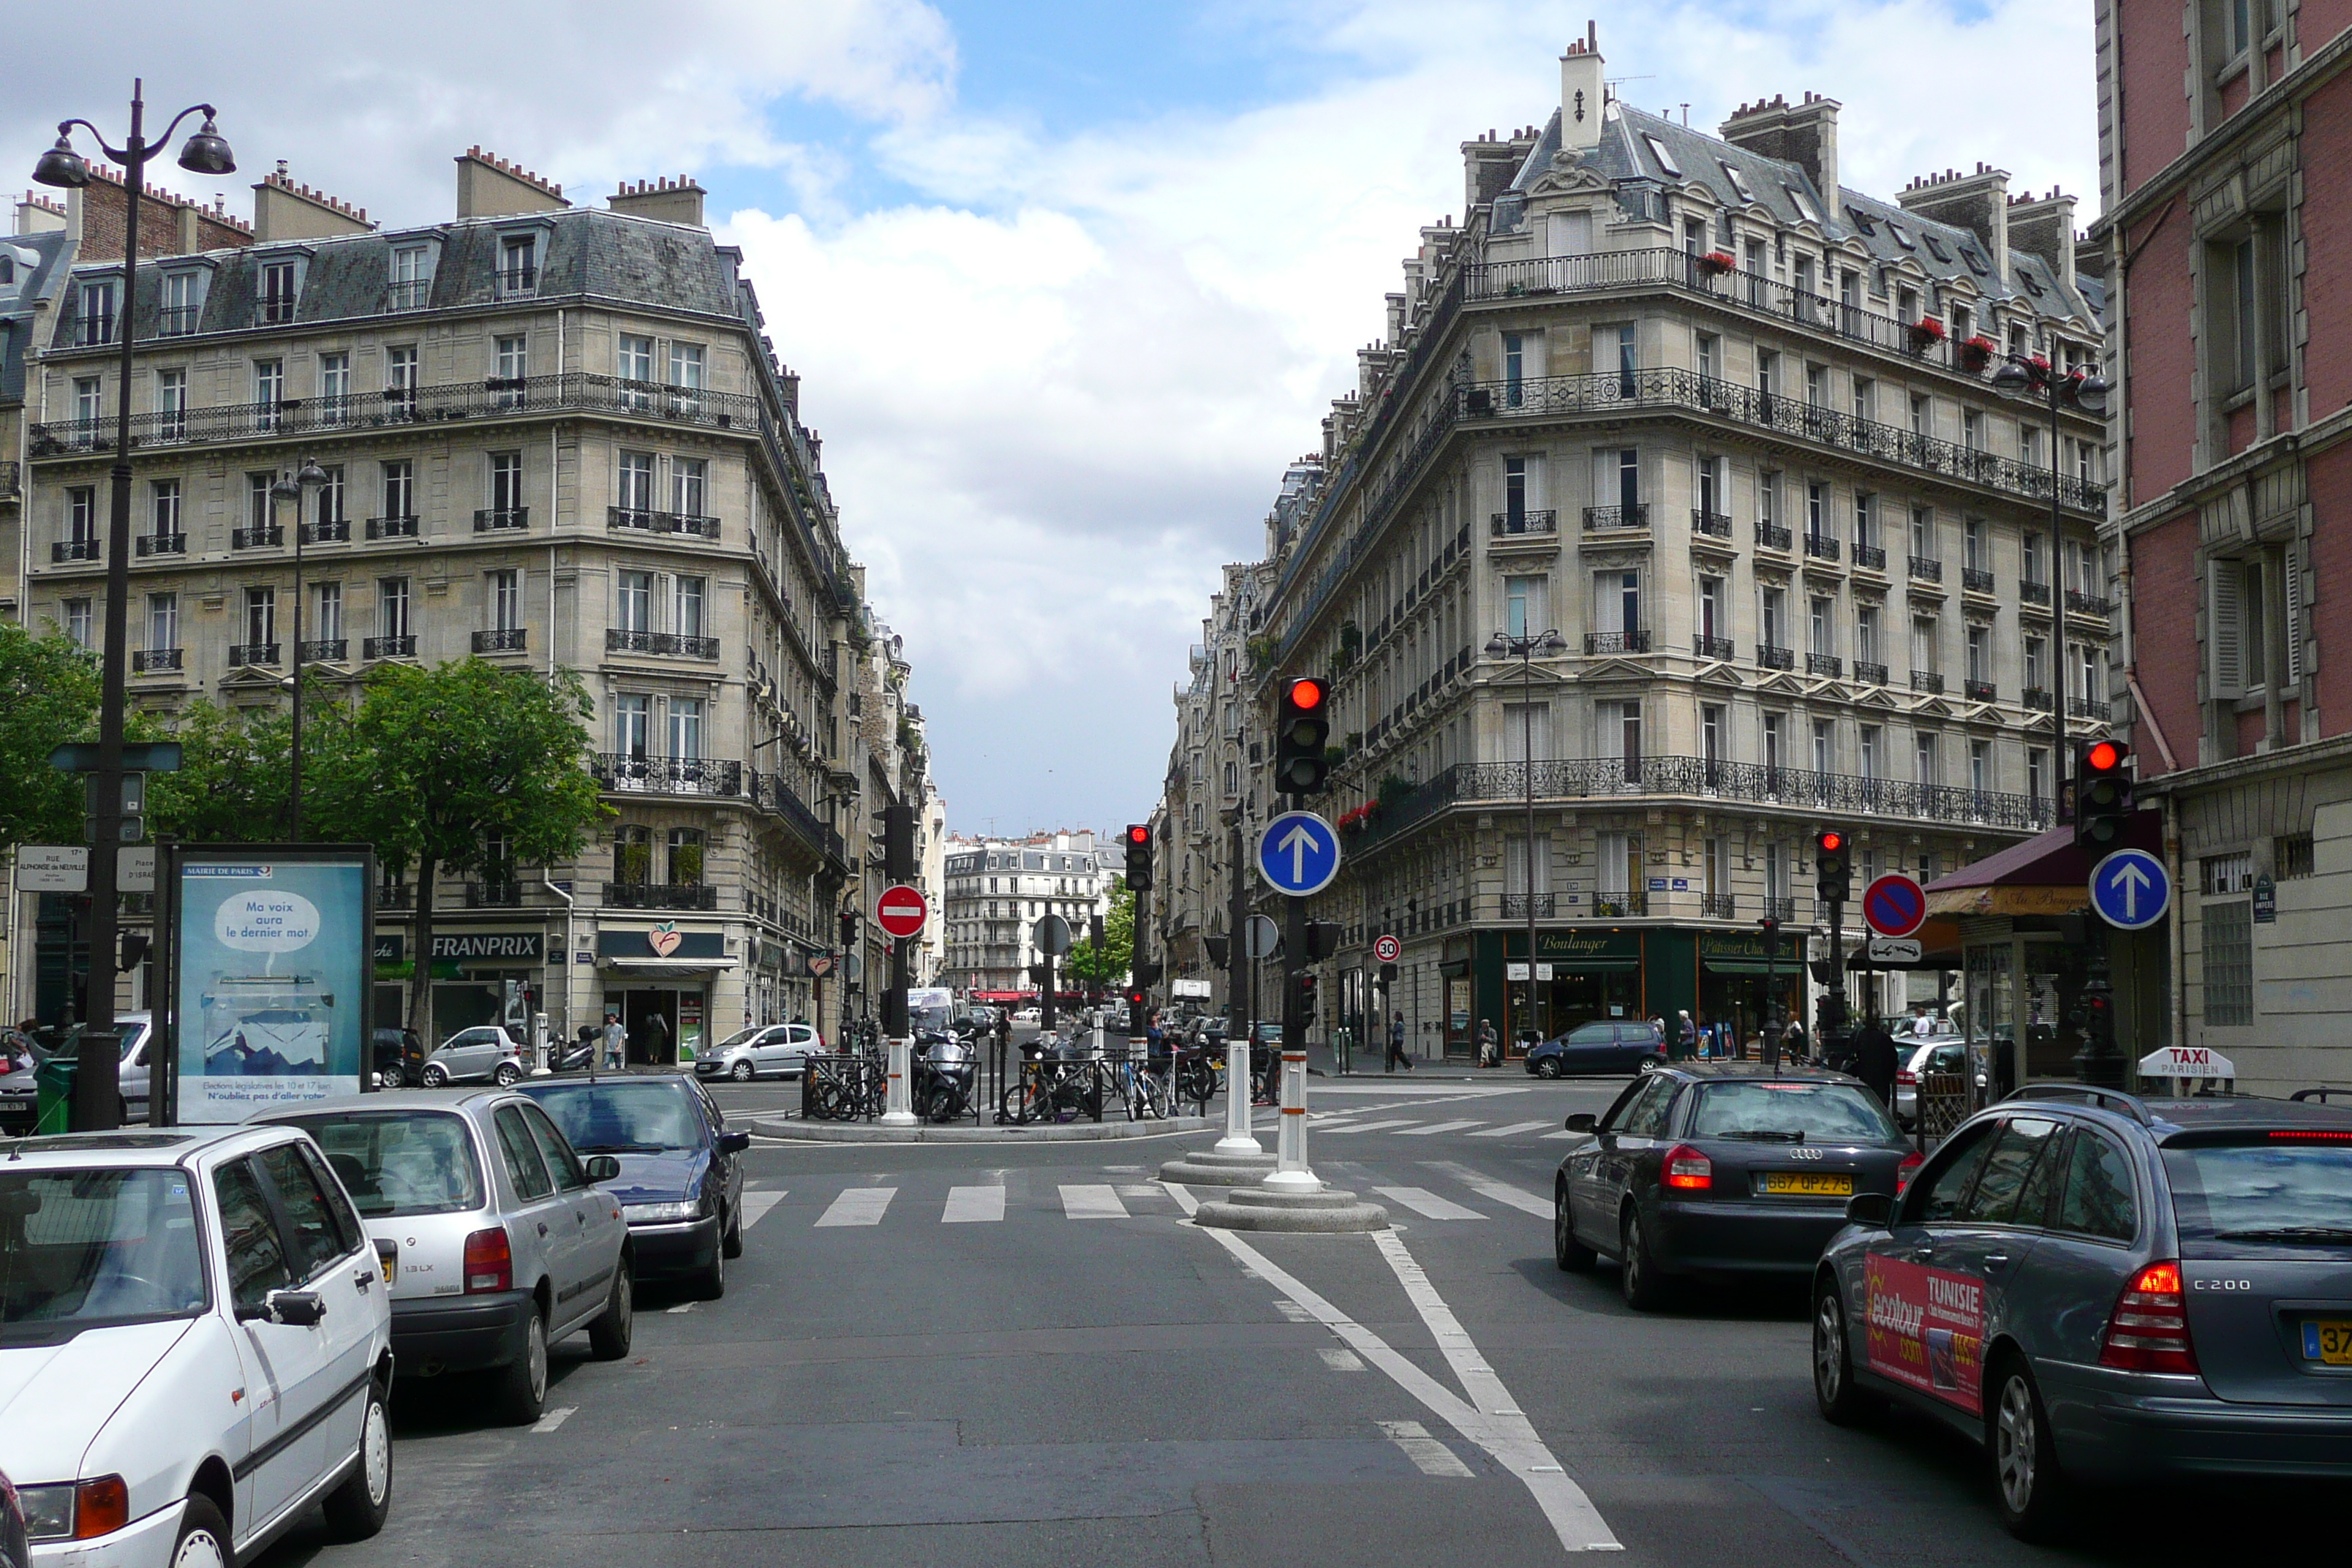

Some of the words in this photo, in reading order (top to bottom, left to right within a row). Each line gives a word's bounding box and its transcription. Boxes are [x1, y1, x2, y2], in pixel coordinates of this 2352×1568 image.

[246, 902, 264, 912] Ma
[268, 902, 293, 912] voix
[256, 916, 282, 925] aura
[226, 926, 236, 937] le
[241, 926, 282, 937] dernier
[431, 936, 536, 957] FRANPRIX
[1380, 943, 1395, 954] 30
[1539, 934, 1608, 955] Boulanger
[1701, 935, 1743, 954] Pâtissier
[2169, 1049, 2209, 1064] TAXI
[2162, 1064, 2219, 1074] PARISIEN
[274, 1081, 284, 1090] les
[287, 1082, 296, 1090] 10
[298, 1082, 305, 1090] et
[307, 1082, 316, 1090] 17
[208, 1092, 250, 1100] N'oubliez
[253, 1093, 269, 1101] pas
[271, 1092, 301, 1100] d'aller
[1768, 1176, 1796, 1189] 667
[1801, 1176, 1829, 1191] QPZ
[1832, 1177, 1850, 1191] 75
[2195, 1281, 2204, 1290] C
[2211, 1281, 2250, 1290] 200
[1927, 1275, 1980, 1313] TUNISIE
[1872, 1292, 1924, 1338] ecotour
[1900, 1337, 1923, 1366] .com
